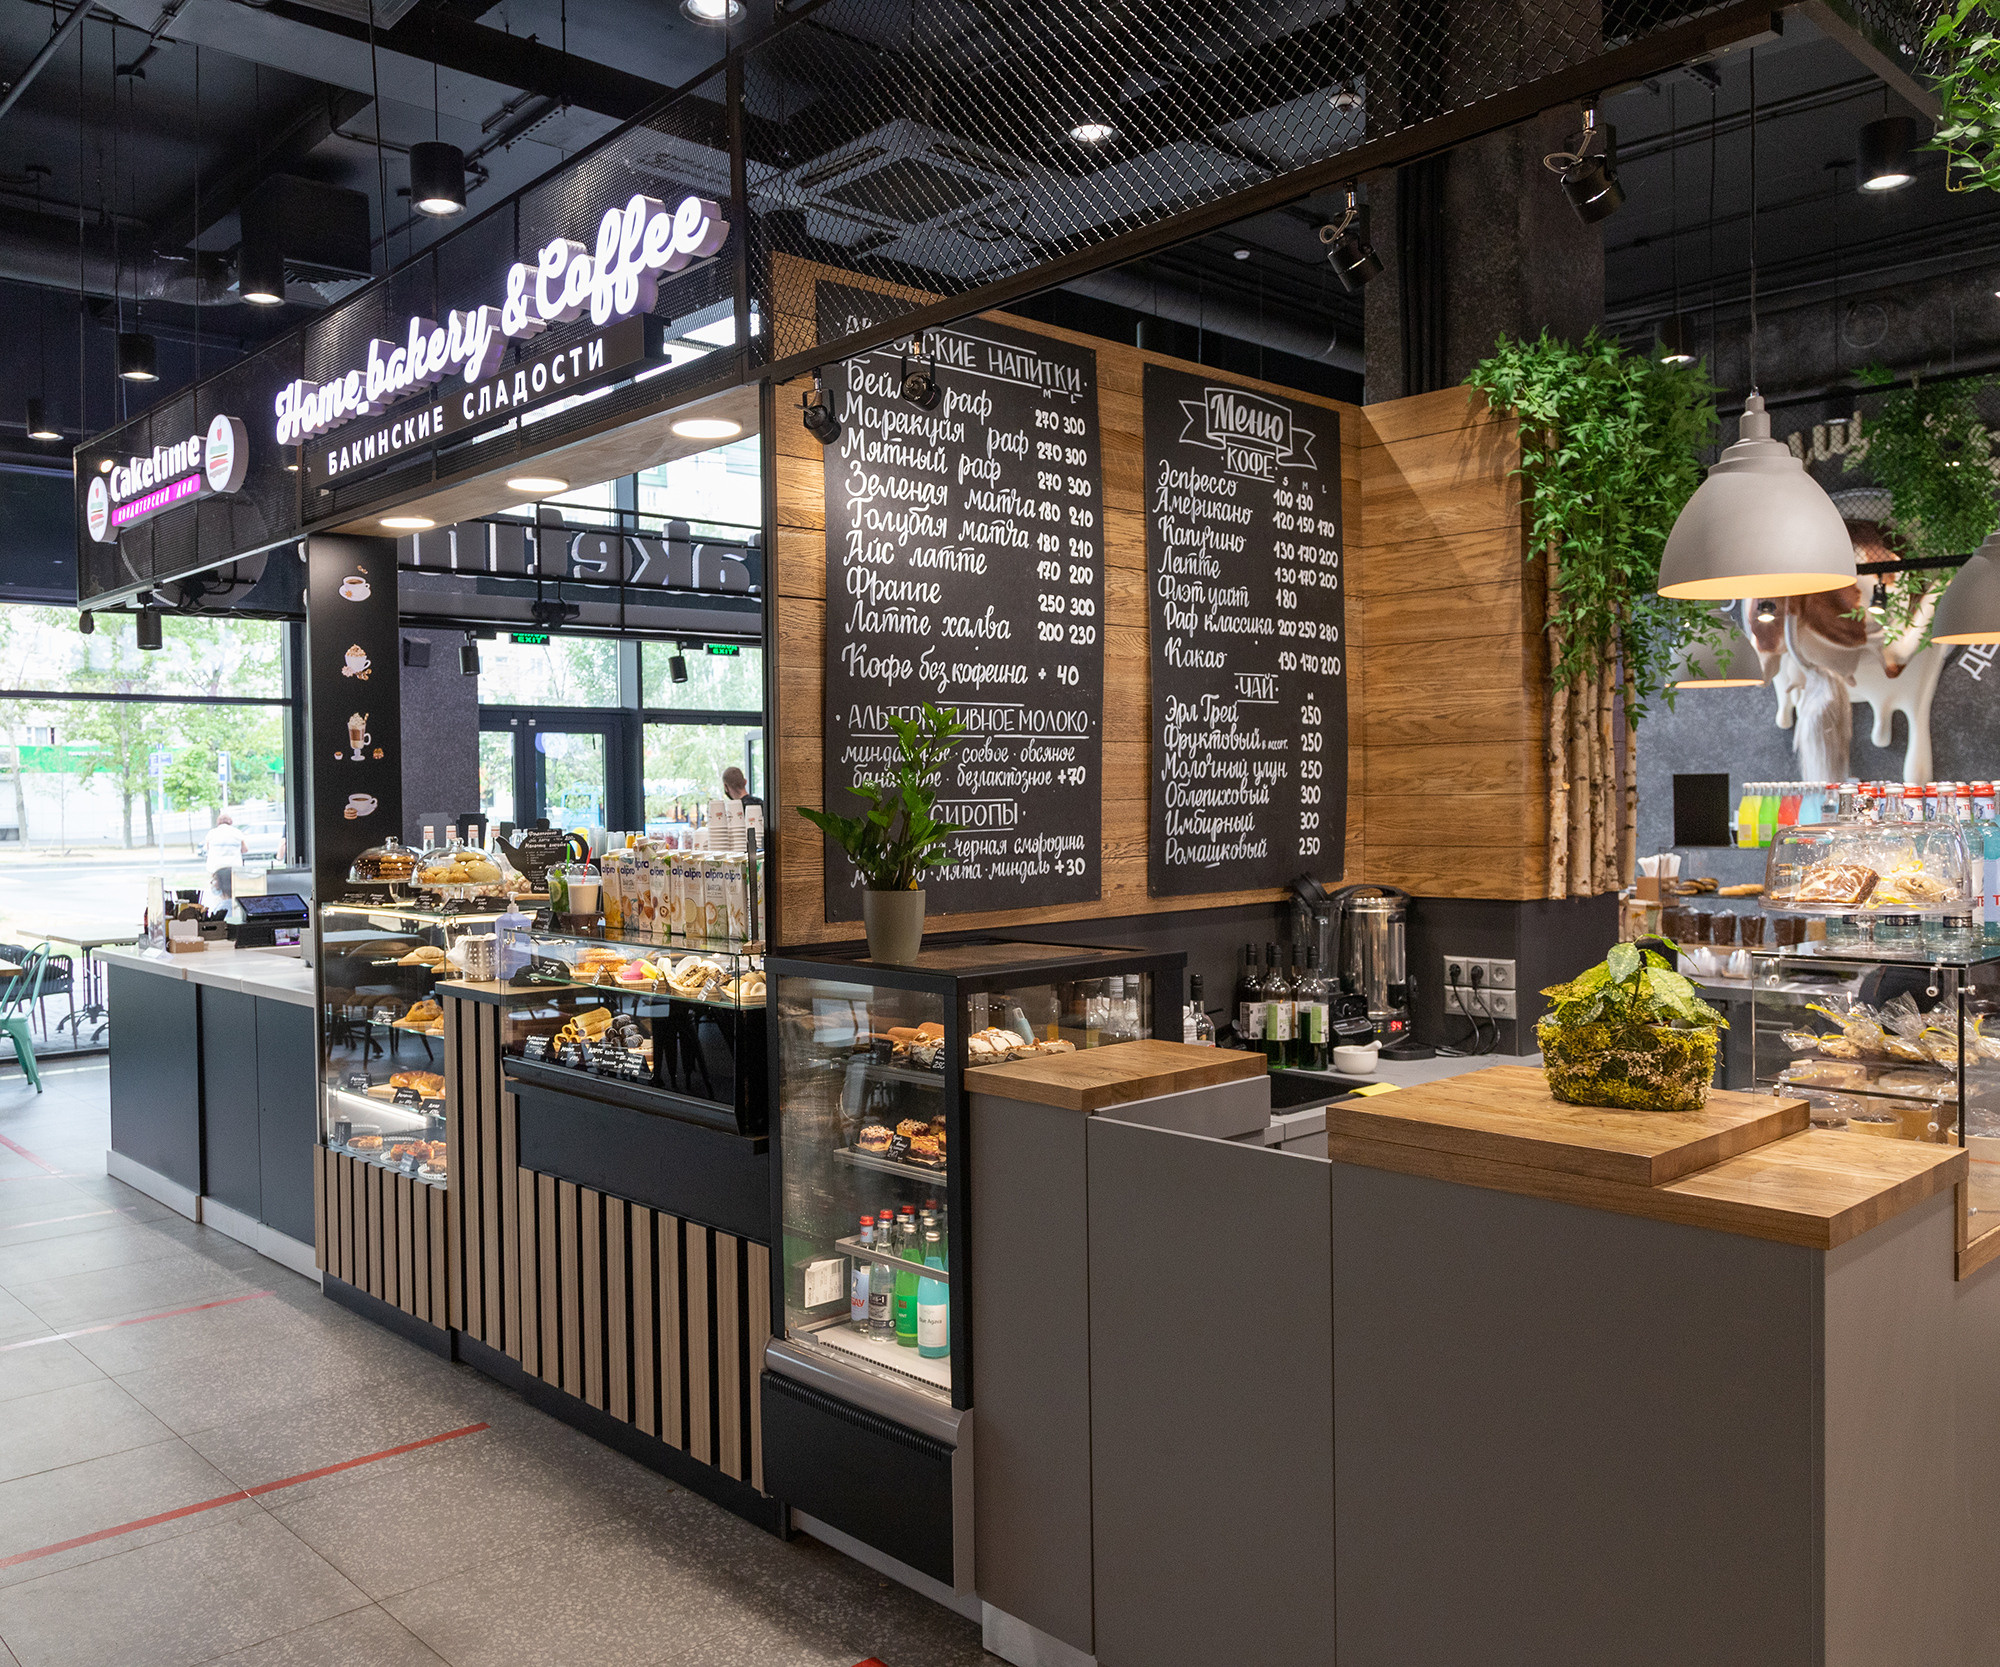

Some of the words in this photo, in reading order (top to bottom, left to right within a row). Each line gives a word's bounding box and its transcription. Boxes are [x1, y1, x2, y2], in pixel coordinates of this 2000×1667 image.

[275, 370, 363, 445] Home
[366, 304, 493, 402] bakery
[502, 263, 529, 336] &
[536, 194, 711, 326] Coffee
[988, 346, 1081, 393] НАПИТКИ
[328, 405, 444, 476] БАКИНСКИЕ
[462, 338, 605, 420] СЛАДОСТИ
[943, 387, 993, 425] раф
[1035, 409, 1060, 429] 270
[1063, 416, 1086, 436] 300
[1210, 393, 1284, 443] Меню
[840, 391, 965, 447] Маракуйя
[987, 426, 1029, 461] раф
[1037, 441, 1062, 461] 270
[1065, 446, 1087, 467] 300
[110, 435, 200, 502] Caketime
[841, 427, 948, 474] Мятный
[958, 453, 1001, 488] раф
[1037, 470, 1062, 491] 270
[1069, 478, 1092, 498] 300
[1227, 446, 1275, 479] КОФЕ
[845, 459, 948, 506] Зеленая
[964, 488, 1036, 518] матча
[1038, 502, 1061, 522] 180
[1069, 507, 1093, 528] 210
[1158, 459, 1239, 497] Эспрессо
[1273, 488, 1294, 507] 100
[1295, 492, 1314, 512] 130
[847, 496, 948, 546] Голубая
[958, 519, 1029, 549] матча
[1037, 532, 1060, 553] 180
[1069, 538, 1093, 559] 210
[1152, 486, 1253, 525] Американо
[1272, 511, 1295, 531] 120
[1296, 516, 1315, 534] 150
[1317, 519, 1335, 538] 170
[843, 529, 895, 567] Айс
[909, 545, 988, 575] латте
[1037, 560, 1062, 581] 170
[1069, 565, 1094, 585] 200
[1158, 515, 1248, 560] Капучино
[1273, 541, 1295, 560] 130
[1298, 544, 1317, 564] 170
[1319, 548, 1339, 569] 200
[1158, 545, 1222, 579] Латте
[1275, 566, 1296, 585] 130
[1298, 569, 1317, 586] 170
[1319, 573, 1338, 590] 200
[846, 565, 942, 606] Фраппе
[1038, 594, 1065, 614] 250
[1070, 598, 1095, 617] 300
[1158, 574, 1206, 604] Флэт
[1276, 588, 1298, 609] 180
[845, 599, 931, 636] Латте
[941, 605, 1011, 640] халва
[1038, 621, 1064, 642] 200
[1069, 624, 1096, 645] 230
[1164, 600, 1198, 638] Раф
[1204, 613, 1275, 636] классика
[1277, 619, 1297, 637] 200
[1298, 621, 1317, 639] 250
[1319, 623, 1339, 642] 280
[841, 642, 914, 687] Кофе
[918, 645, 950, 694] без
[952, 661, 1029, 690] кофеина
[1057, 664, 1080, 686] 40
[1164, 636, 1228, 668] Какао
[1278, 651, 1298, 671] 130
[1300, 653, 1319, 673] 170
[1321, 656, 1341, 676] 200
[1239, 673, 1274, 700] ЧАЙ
[1019, 709, 1089, 734] МОЛОКО
[1165, 694, 1198, 730] Эрл
[1200, 693, 1240, 729] Грей
[1301, 706, 1322, 726] 250
[962, 735, 1009, 763] соевое
[1020, 738, 1075, 763] овсяное
[1163, 722, 1261, 760] Фруктовый
[1301, 732, 1323, 752] 250
[957, 763, 1053, 795] безлактозное
[1161, 752, 1249, 781] Молочный
[1253, 761, 1288, 786] улун
[1301, 760, 1323, 780] 250
[1165, 778, 1270, 809] Облепиховый
[1301, 785, 1321, 805] 300
[929, 803, 1018, 826] СИРОПЫ
[1165, 809, 1255, 842] Имбирный
[1300, 812, 1319, 830] 300
[635, 857, 650, 871] lpro
[955, 838, 1007, 862] черная
[1014, 833, 1085, 860] смородина
[1165, 832, 1268, 867] Ромашковый
[1299, 837, 1320, 856] 250
[705, 869, 723, 881] alpro
[725, 870, 742, 882] alpro
[936, 859, 982, 881] мята
[988, 857, 1050, 883] миндаль
